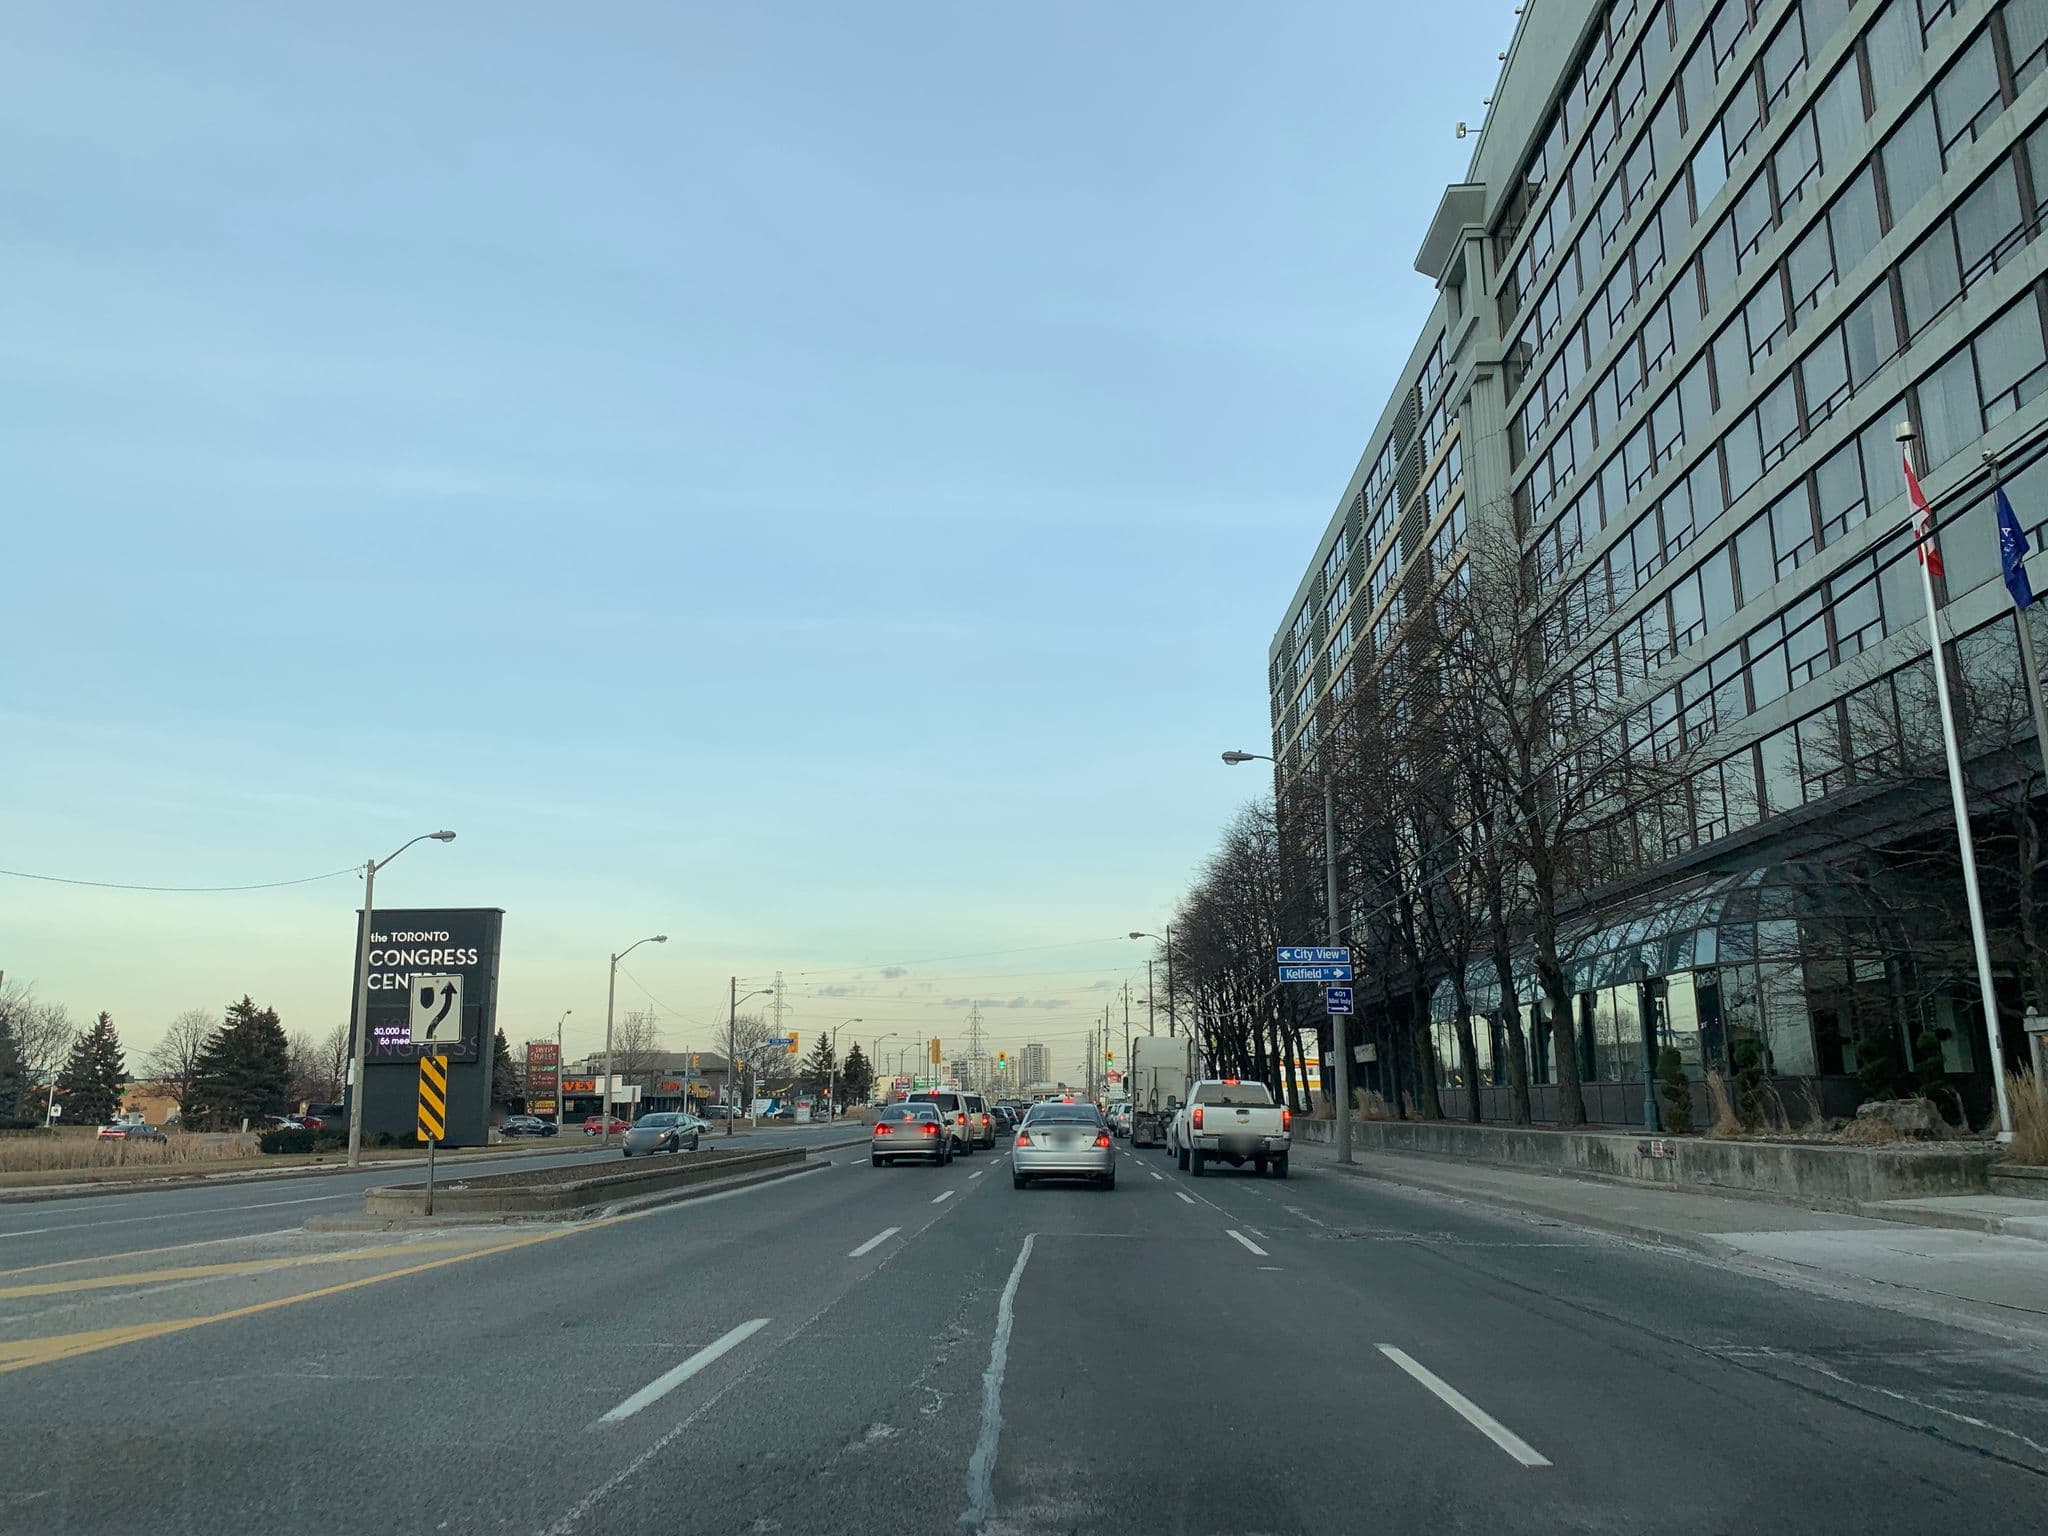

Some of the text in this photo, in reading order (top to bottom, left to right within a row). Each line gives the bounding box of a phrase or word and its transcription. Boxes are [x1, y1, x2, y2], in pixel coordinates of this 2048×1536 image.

[370, 931, 449, 943] the TORONTO
[369, 948, 478, 966] CONGRESS
[1294, 949, 1313, 961] City
[1316, 949, 1339, 959] View
[1286, 968, 1322, 979] Kelfield
